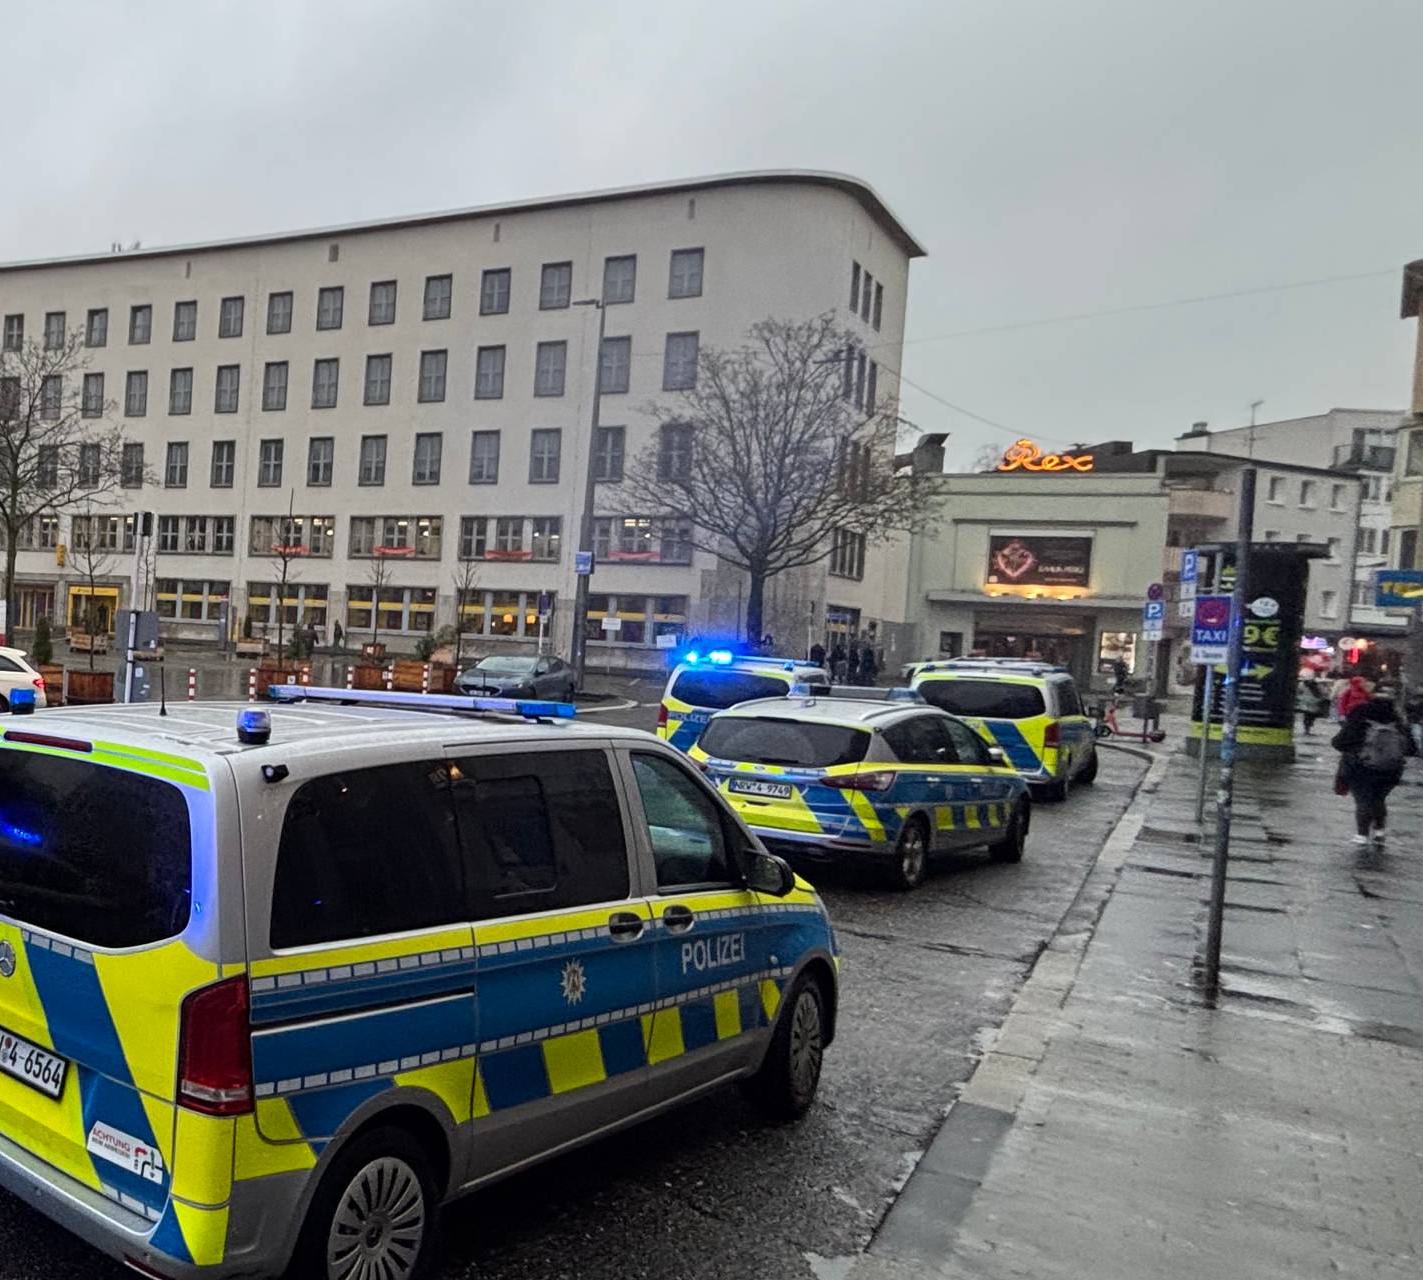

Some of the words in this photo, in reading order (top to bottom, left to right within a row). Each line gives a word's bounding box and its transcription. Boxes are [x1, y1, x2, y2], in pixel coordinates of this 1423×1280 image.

[997, 439, 1094, 471] Rex
[1196, 629, 1227, 642] TAXI
[1243, 625, 1281, 646] 9€
[681, 933, 745, 974] POLIZEI
[8, 1041, 62, 1090] 4-6564
[92, 1126, 131, 1153] ACHTUNG
